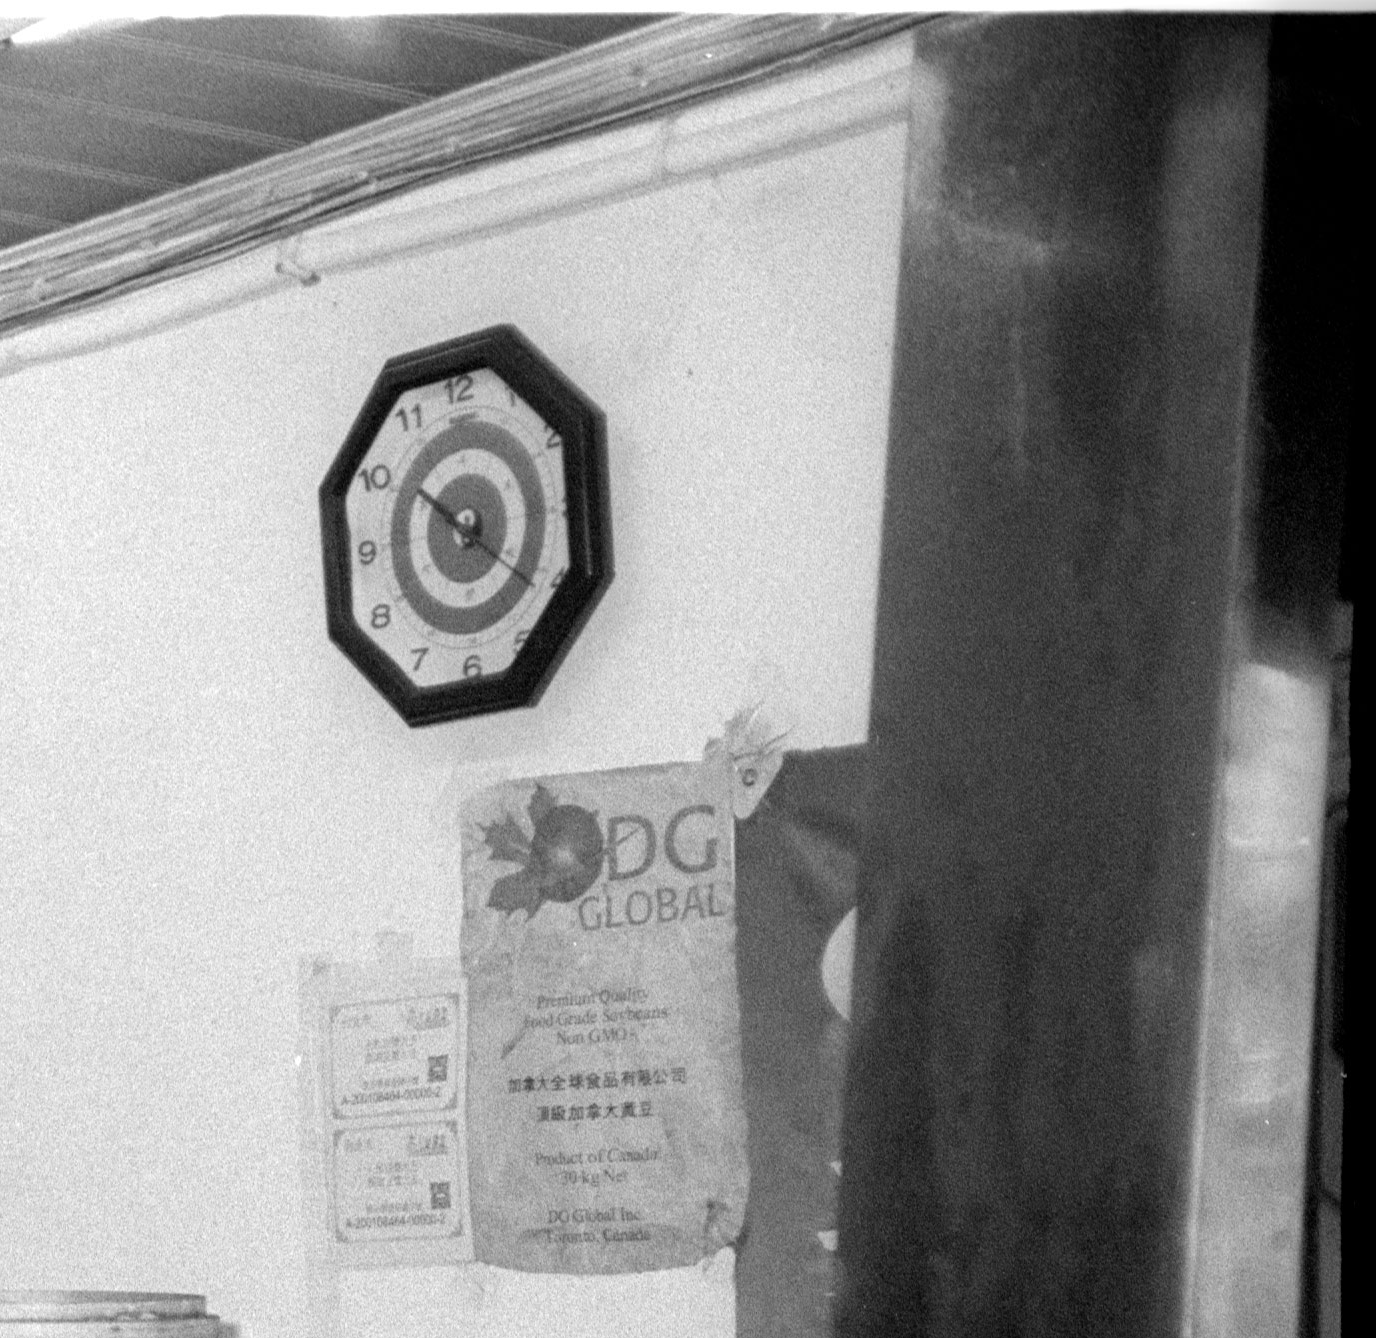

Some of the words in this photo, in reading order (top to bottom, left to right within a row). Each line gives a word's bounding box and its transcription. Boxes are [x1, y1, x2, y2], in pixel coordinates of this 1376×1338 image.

[443, 374, 475, 404] 12
[395, 404, 423, 432] 11
[358, 463, 392, 492] 10
[358, 539, 377, 566] 9
[370, 603, 392, 630] 8
[410, 647, 430, 672] 7
[461, 655, 483, 679] 6
[608, 803, 719, 882] DG
[577, 882, 727, 932] GLOBAL
[556, 1010, 597, 1027] Grade
[556, 1030, 586, 1045] Non
[534, 1151, 584, 1167] Product
